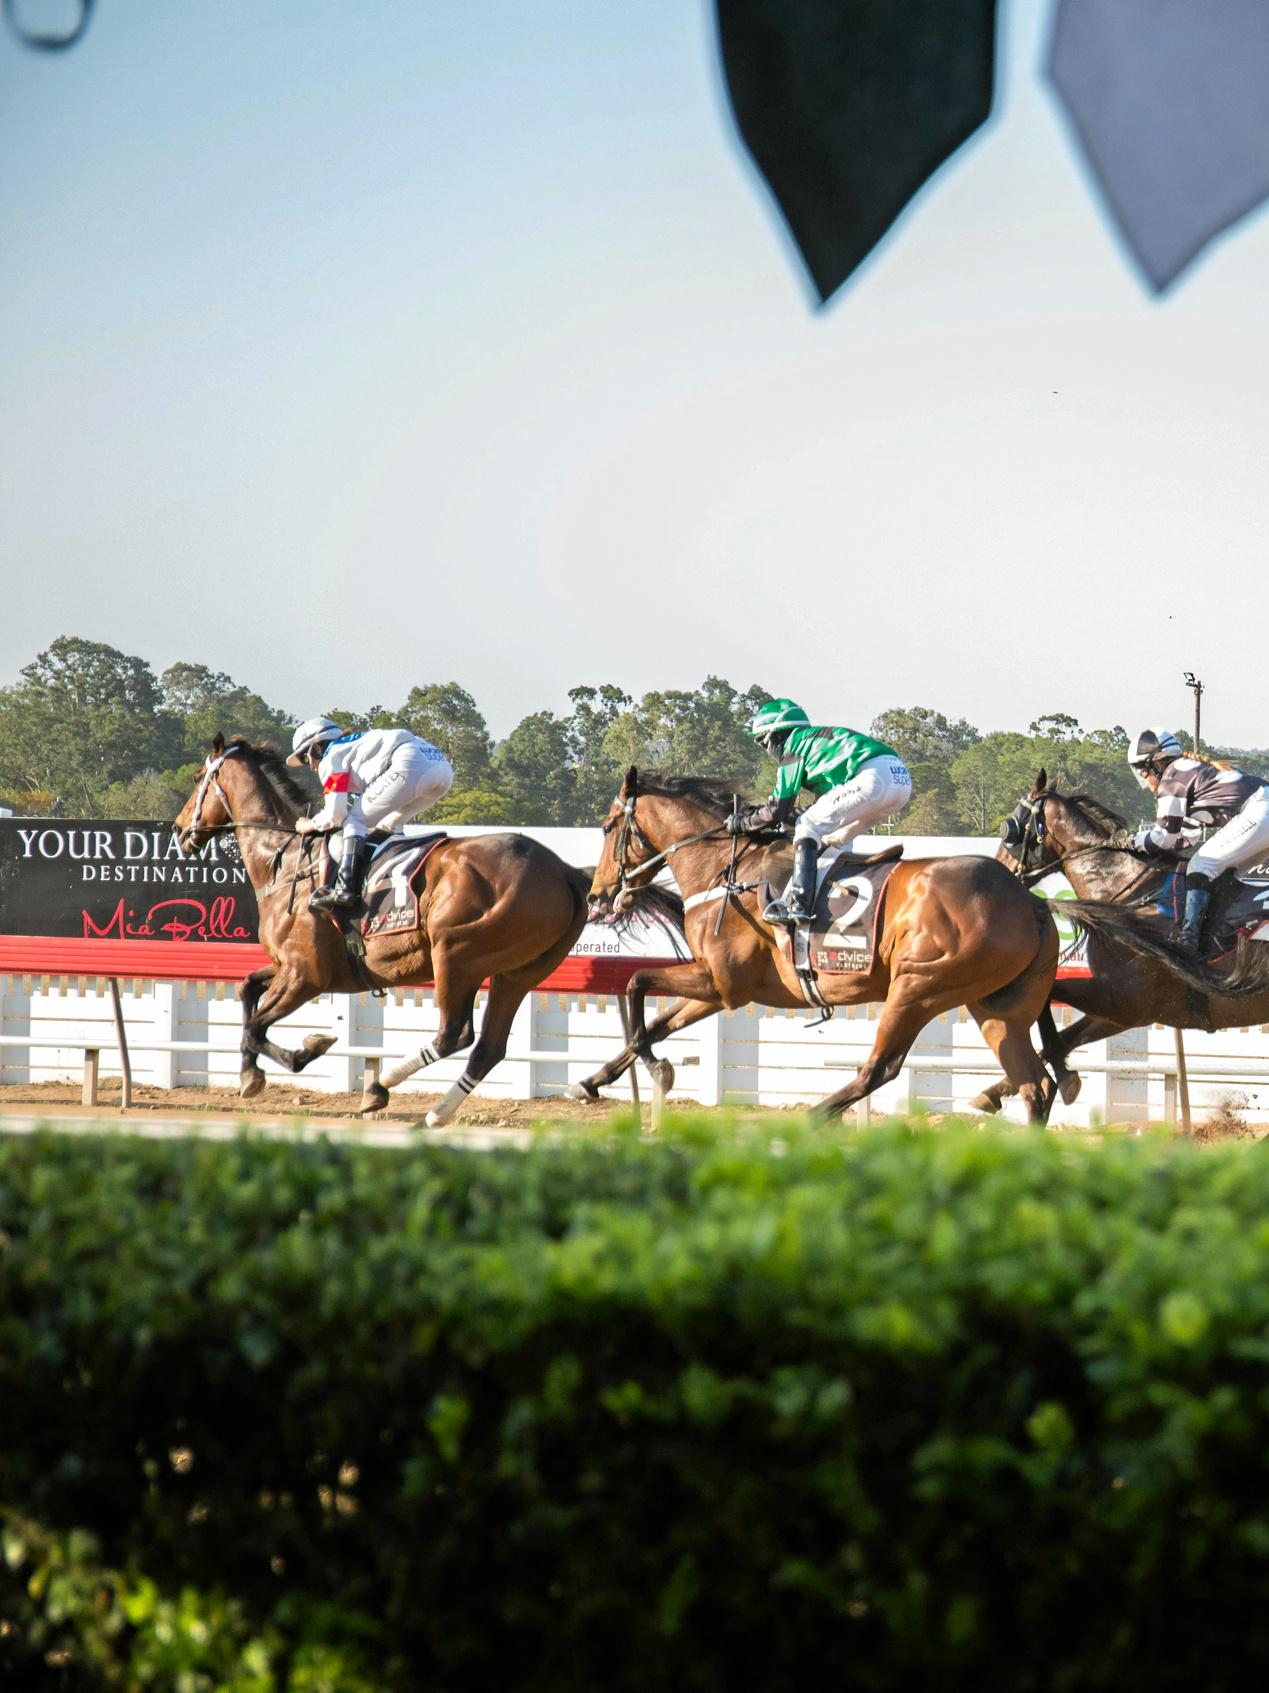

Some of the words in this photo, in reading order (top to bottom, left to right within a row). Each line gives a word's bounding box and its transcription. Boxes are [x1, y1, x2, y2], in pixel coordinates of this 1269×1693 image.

[17, 829, 116, 859] YOUR
[82, 898, 155, 940] Mia
[148, 896, 251, 942] Bella
[822, 876, 873, 949] 2
[829, 950, 872, 963] advice
